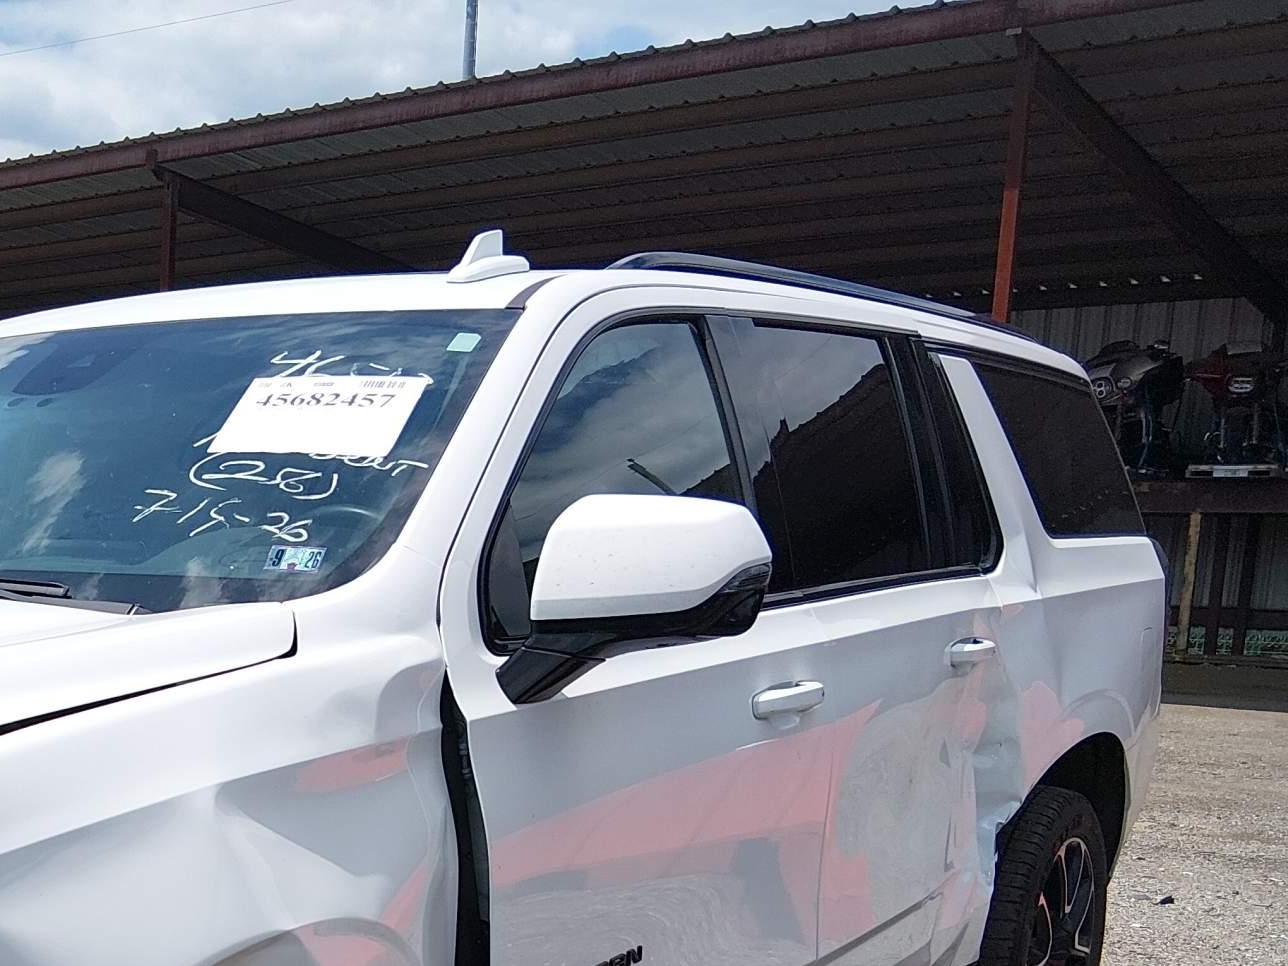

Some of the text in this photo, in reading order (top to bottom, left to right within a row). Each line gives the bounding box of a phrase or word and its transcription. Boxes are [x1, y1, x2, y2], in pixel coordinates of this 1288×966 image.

[256, 392, 397, 408] 45682457
[272, 548, 323, 569] 9 26
